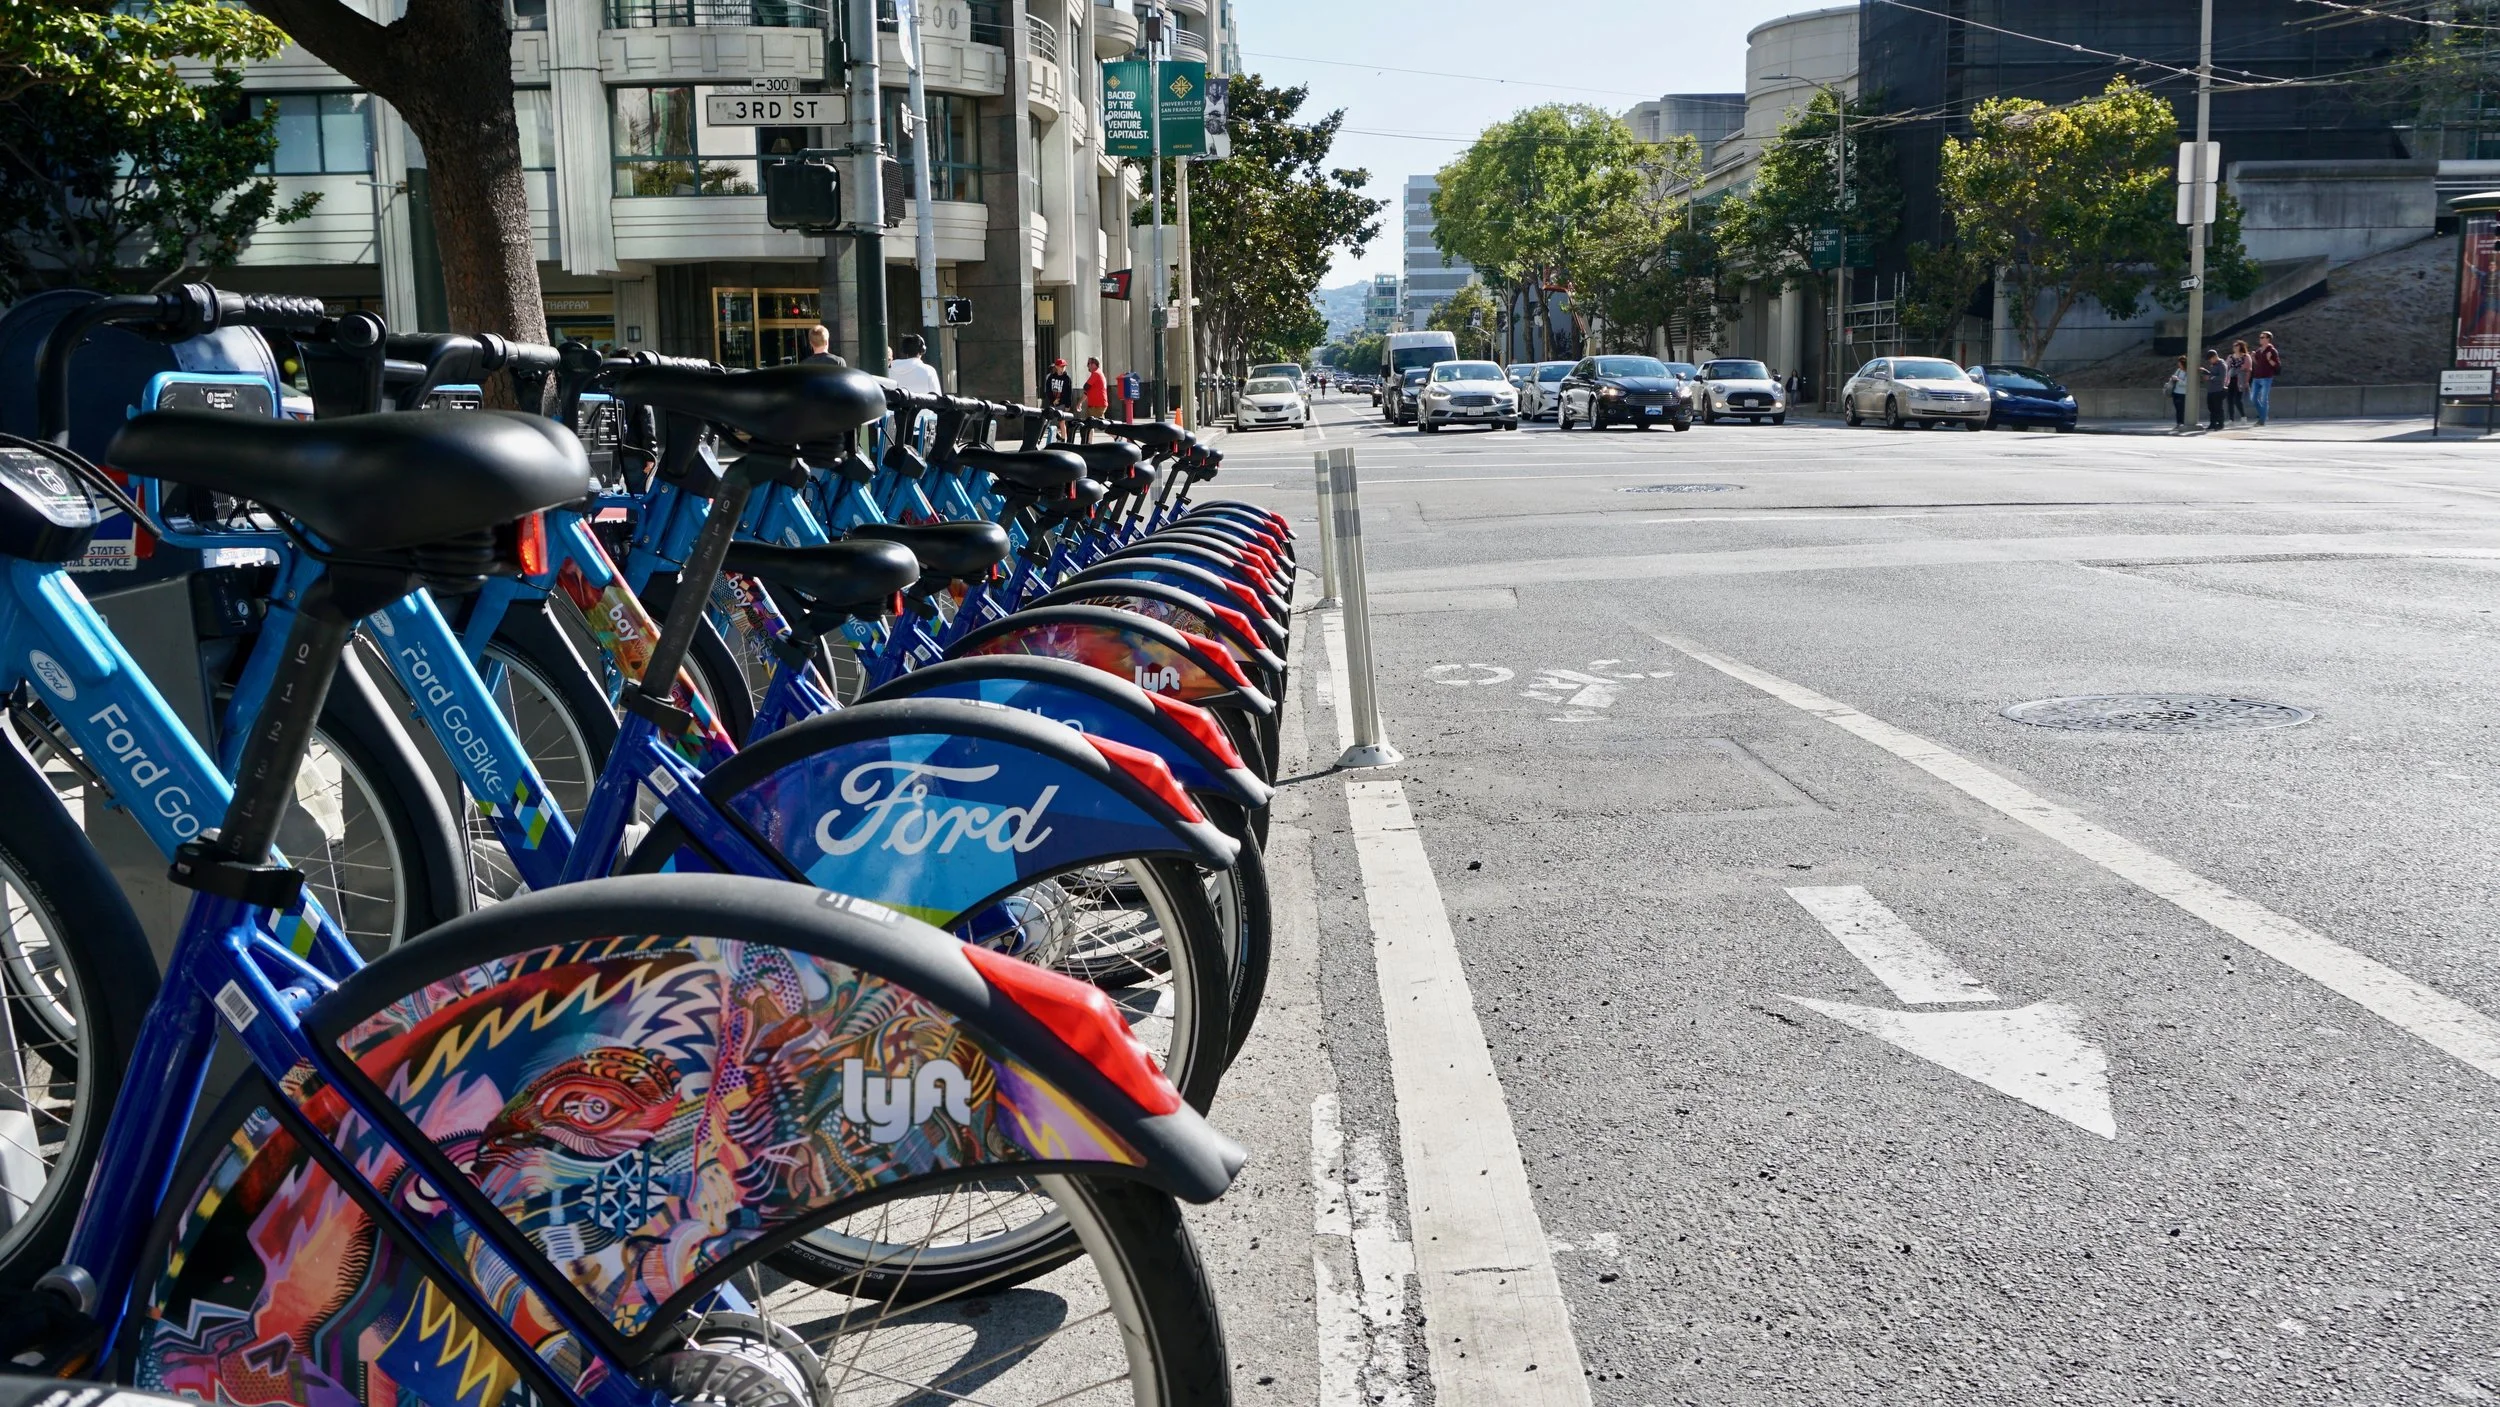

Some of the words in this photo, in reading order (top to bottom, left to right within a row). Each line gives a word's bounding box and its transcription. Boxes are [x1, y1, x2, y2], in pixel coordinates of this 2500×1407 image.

[766, 79, 789, 91] 300
[1107, 91, 1136, 100] BACKED
[735, 101, 782, 119] 3RD
[793, 101, 818, 119] ST
[1107, 101, 1119, 109] BY
[1120, 101, 1133, 109] THE
[1107, 110, 1142, 119] ORIGINAL
[1108, 120, 1141, 129] VENTURE
[1107, 130, 1150, 139] CAPITALIST.
[545, 300, 589, 310] THAPPAM
[90, 546, 127, 555] STATES
[88, 558, 130, 567] SERVICE
[727, 575, 751, 607] bay
[608, 602, 639, 642] bay
[36, 658, 68, 692] Ford
[1134, 665, 1181, 693] lyft
[401, 641, 455, 707] Ford
[442, 705, 503, 795] GoBike
[88, 703, 170, 788] Ford
[154, 786, 200, 843] Go
[815, 760, 1061, 856] Ford
[842, 1057, 973, 1144] lyft
